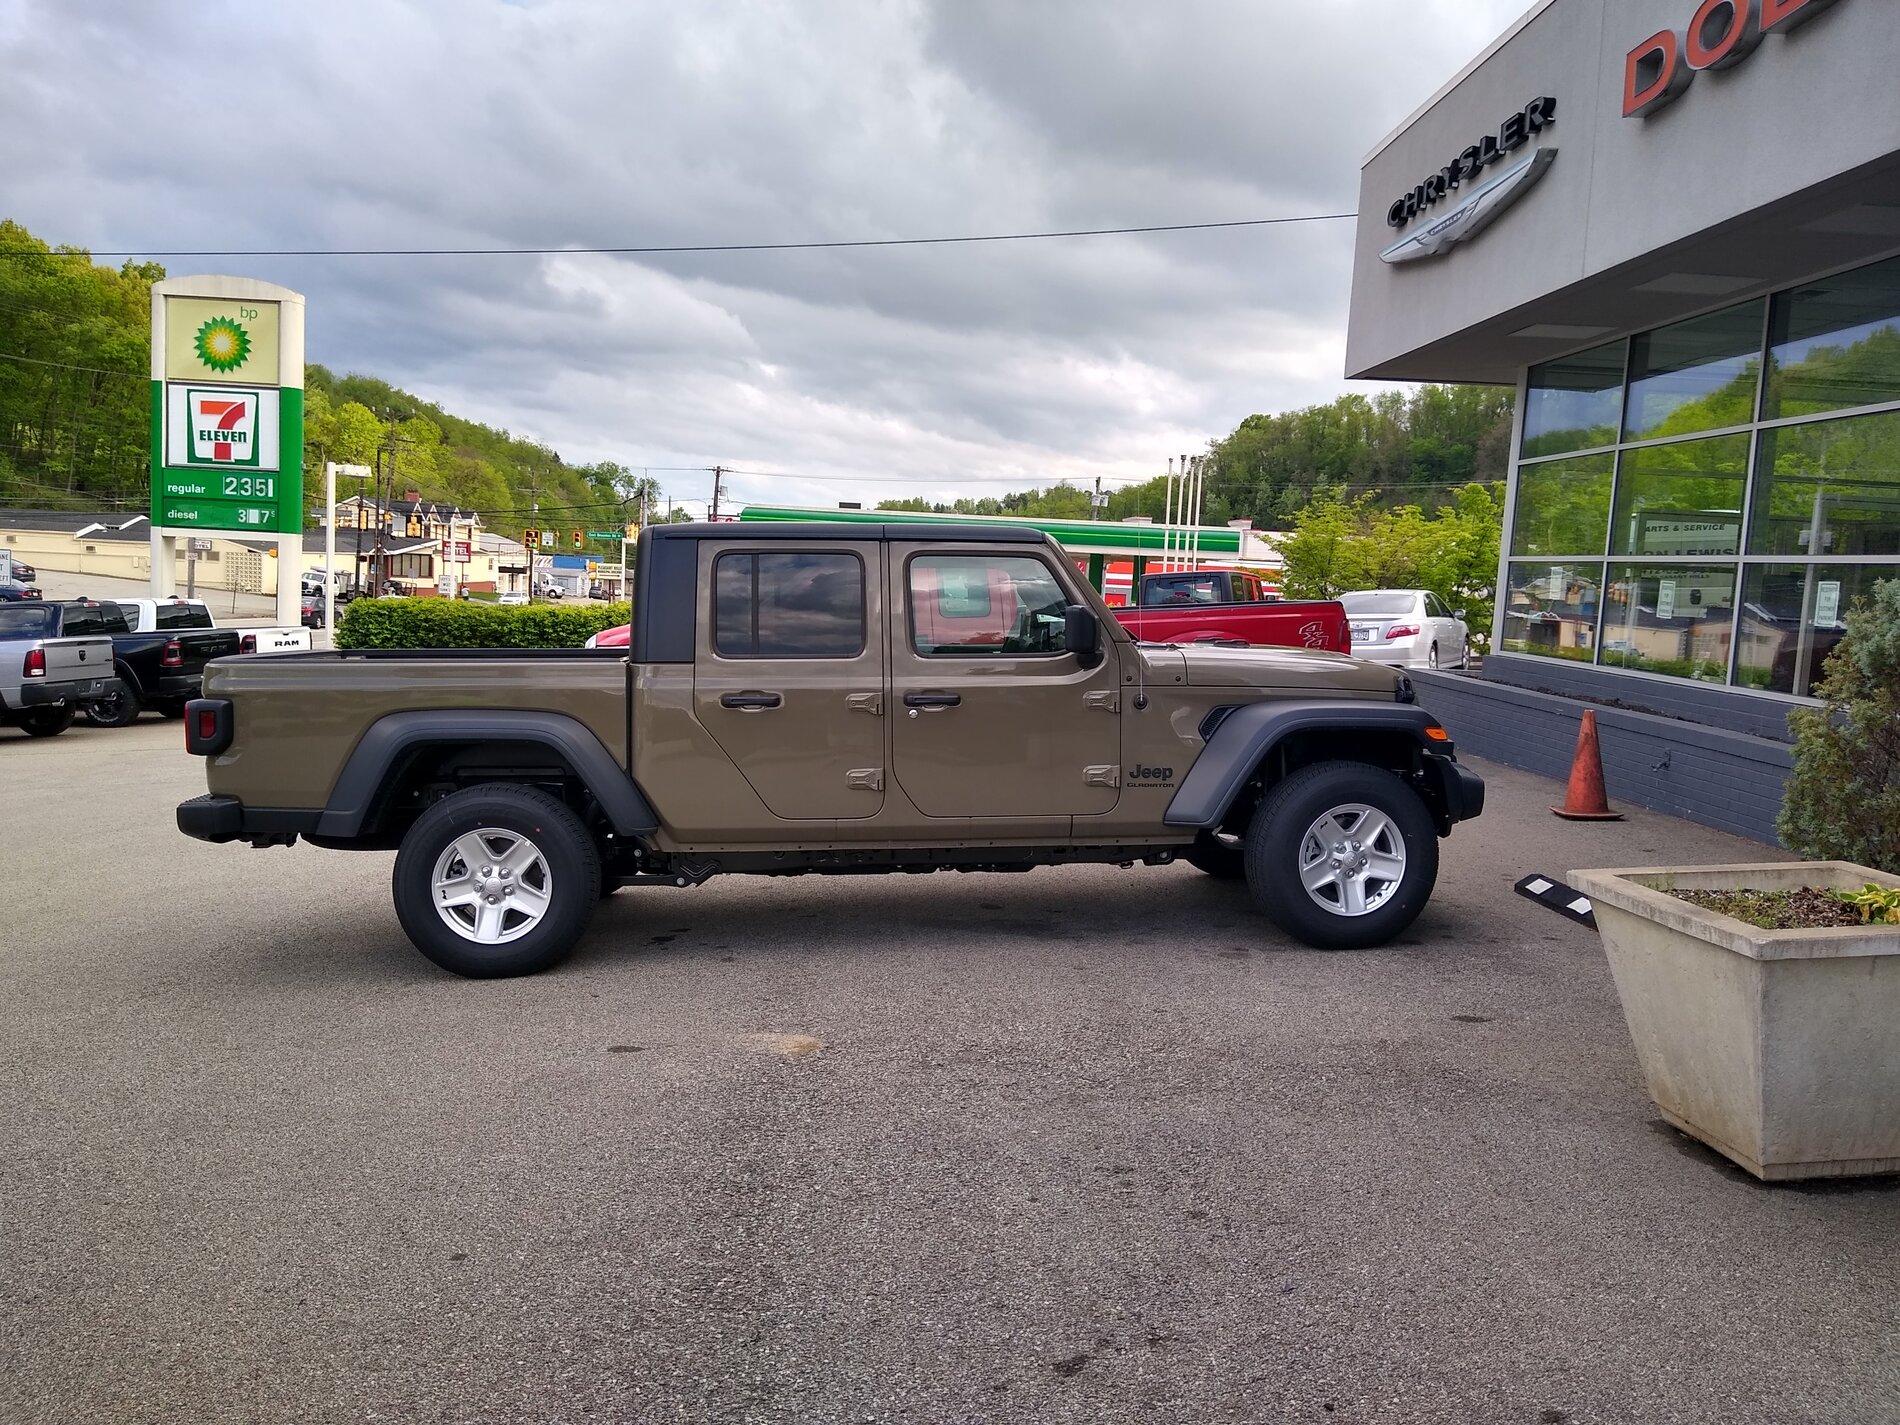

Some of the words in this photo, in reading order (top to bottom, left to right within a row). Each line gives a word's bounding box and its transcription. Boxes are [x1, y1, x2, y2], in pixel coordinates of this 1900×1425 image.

[1387, 96, 1557, 228] CHRYSLER
[240, 306, 258, 320] bp
[200, 400, 246, 460] 7
[167, 484, 206, 496] regular
[167, 509, 198, 520] diesel
[1129, 764, 1174, 781] Jeep
